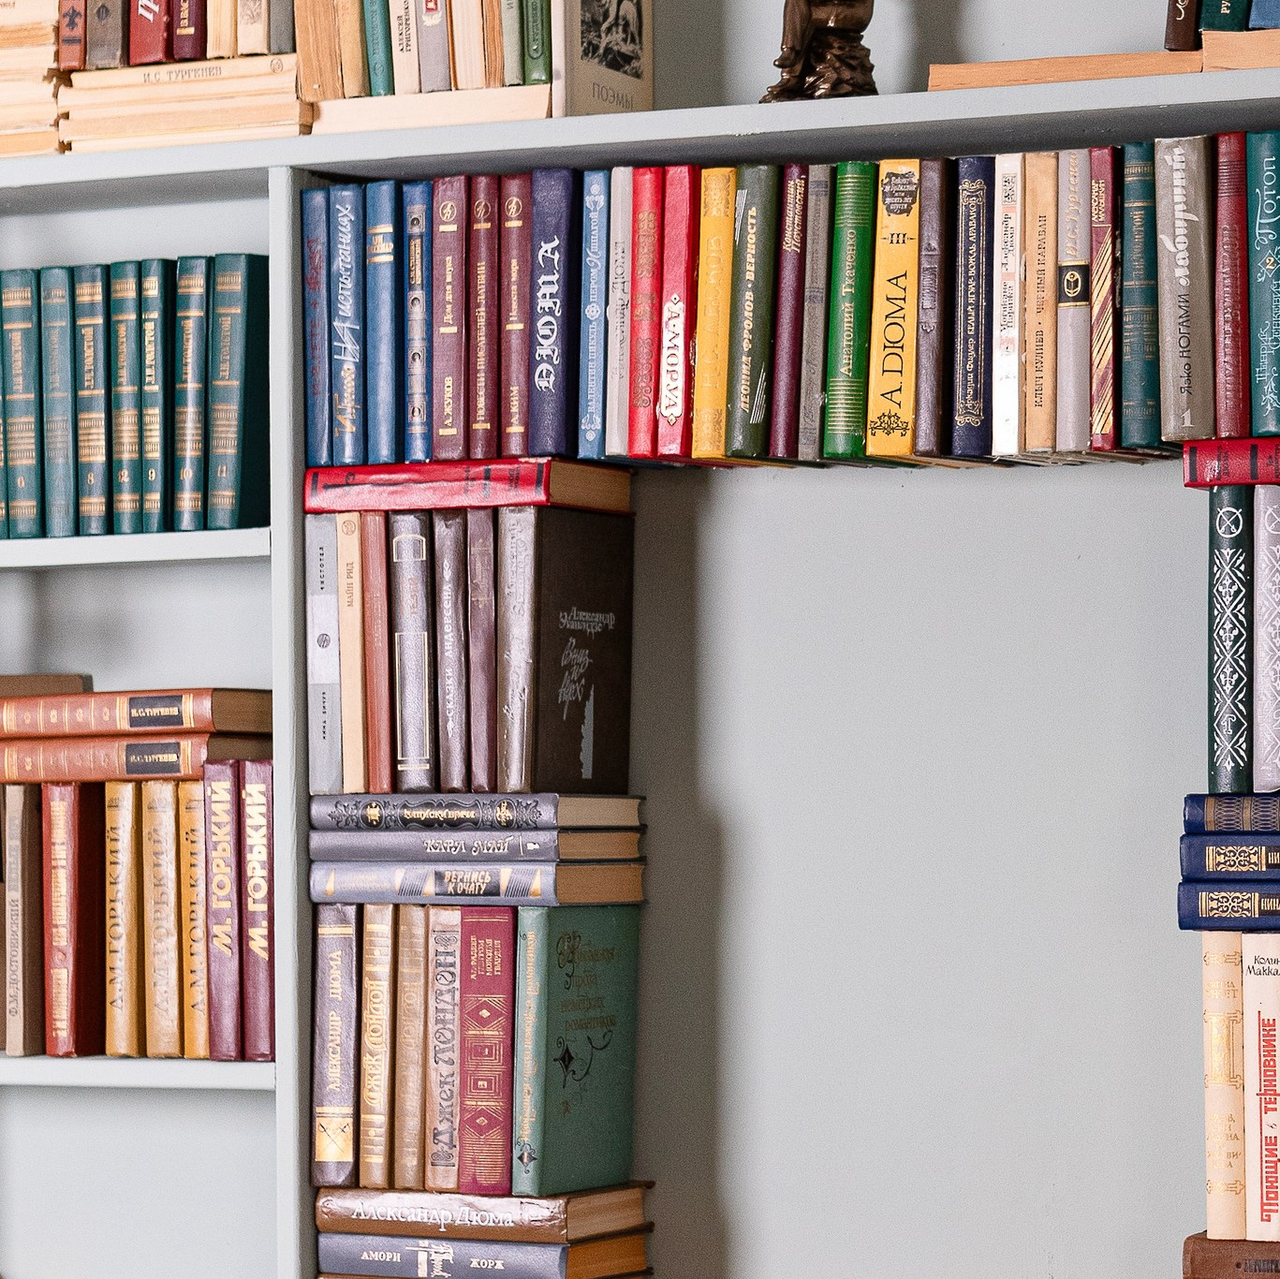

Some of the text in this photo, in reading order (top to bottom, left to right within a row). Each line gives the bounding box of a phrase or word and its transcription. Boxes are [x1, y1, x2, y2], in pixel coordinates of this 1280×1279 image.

[334, 204, 355, 317] испытаниях
[783, 179, 795, 251] Константин
[791, 177, 804, 253] Паустовский
[535, 235, 561, 393] ДЮМА
[740, 206, 757, 413] ЛЕОНИД ФРОЛОВ ВЕРНОСТЬ
[840, 229, 857, 377] Анатолий Ткаченко
[206, 780, 232, 956] М. ГОРЬКИЙ
[444, 870, 491, 883] ВЕРНИСЬ
[447, 882, 488, 895] К ОЧАГУ
[327, 949, 342, 1092] АЛЕКСАНДР ДЮМА
[361, 1251, 505, 1270] АМОРИ ЖОРЖ
